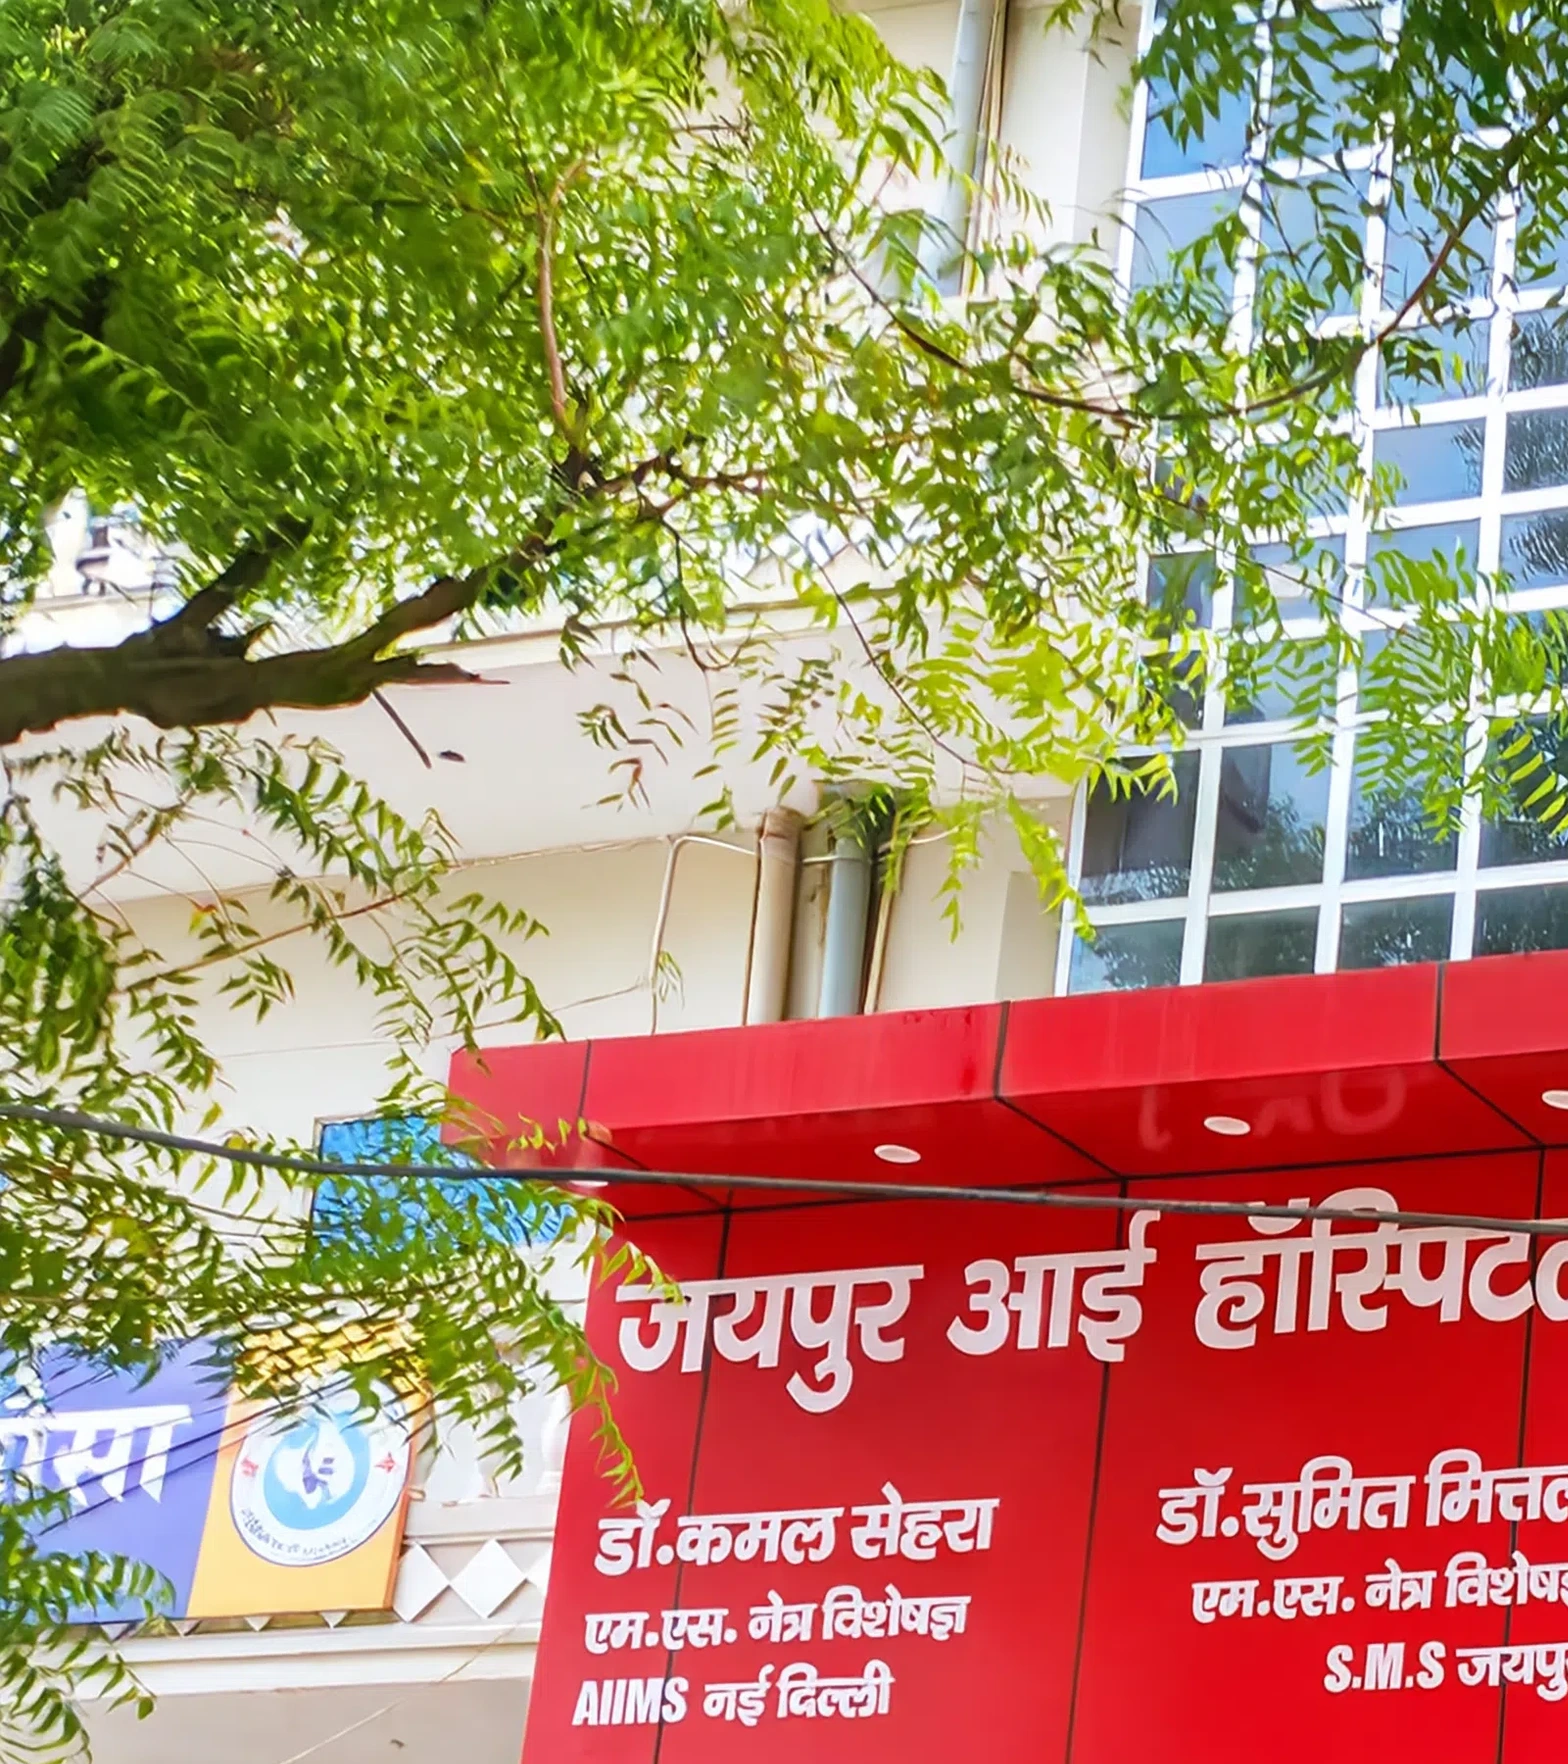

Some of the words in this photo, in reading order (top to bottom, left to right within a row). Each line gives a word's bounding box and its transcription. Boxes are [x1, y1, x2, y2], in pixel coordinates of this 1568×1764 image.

[615, 1264, 924, 1413] जयपुर
[946, 1210, 1160, 1362] आई
[594, 1498, 843, 1575] डॉ.कमल
[850, 1482, 1000, 1562] सेहरा
[1156, 1455, 1416, 1561] डॉ.सुमित
[584, 1607, 737, 1654] एम.एस.
[748, 1590, 816, 1642] नेत्र
[821, 1583, 972, 1641] विशेषज्ञ
[1191, 1576, 1356, 1623] एम.एस.
[1365, 1558, 1437, 1612] नेत्र
[572, 1676, 690, 1726] AIIMS
[703, 1664, 774, 1726] नई
[775, 1658, 895, 1719] दिल्ली
[1323, 1641, 1446, 1694] S.M.S
